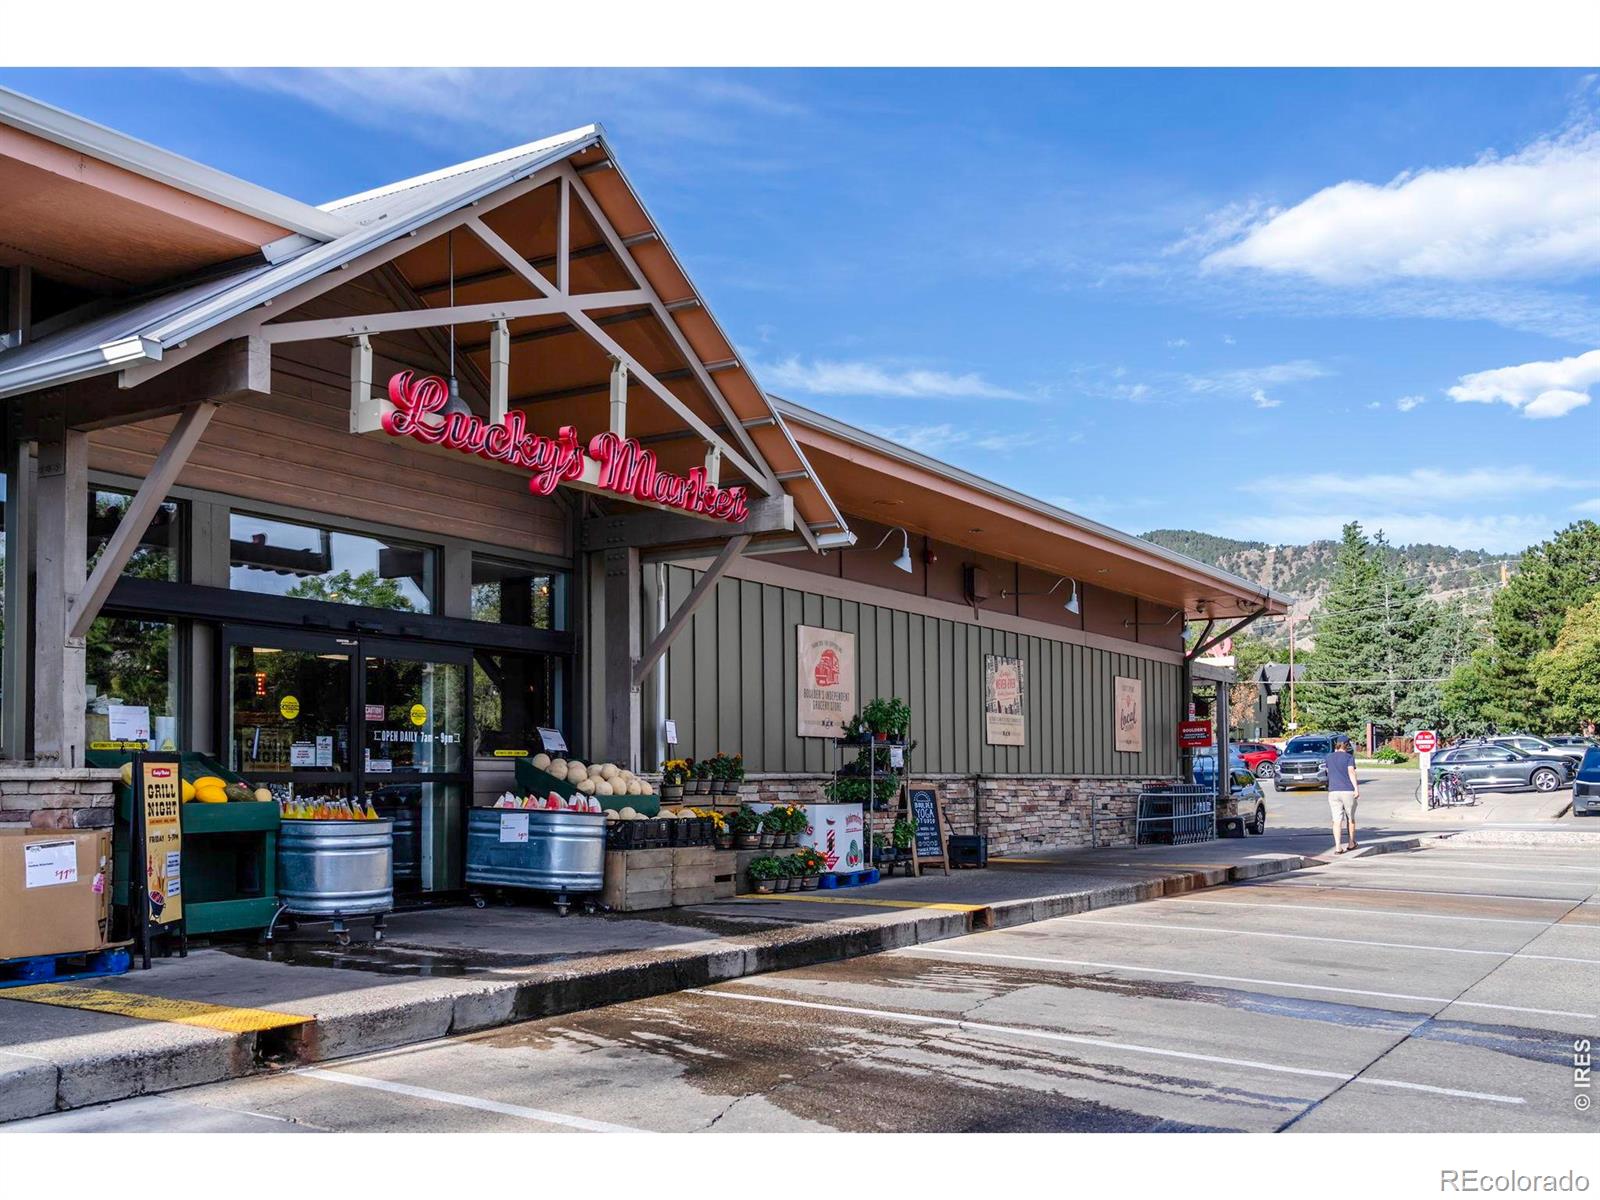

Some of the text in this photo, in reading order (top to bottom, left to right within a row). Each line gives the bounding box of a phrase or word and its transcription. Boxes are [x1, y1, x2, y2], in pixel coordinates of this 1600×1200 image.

[381, 369, 750, 523] Lucky's Market
[382, 730, 398, 740] OPEN
[400, 731, 418, 742] DAILY
[420, 732, 432, 742] 7am
[440, 732, 454, 746] 9pm
[148, 784, 176, 798] GRILL
[148, 801, 177, 816] NIGHT
[916, 808, 934, 818] YOGA
